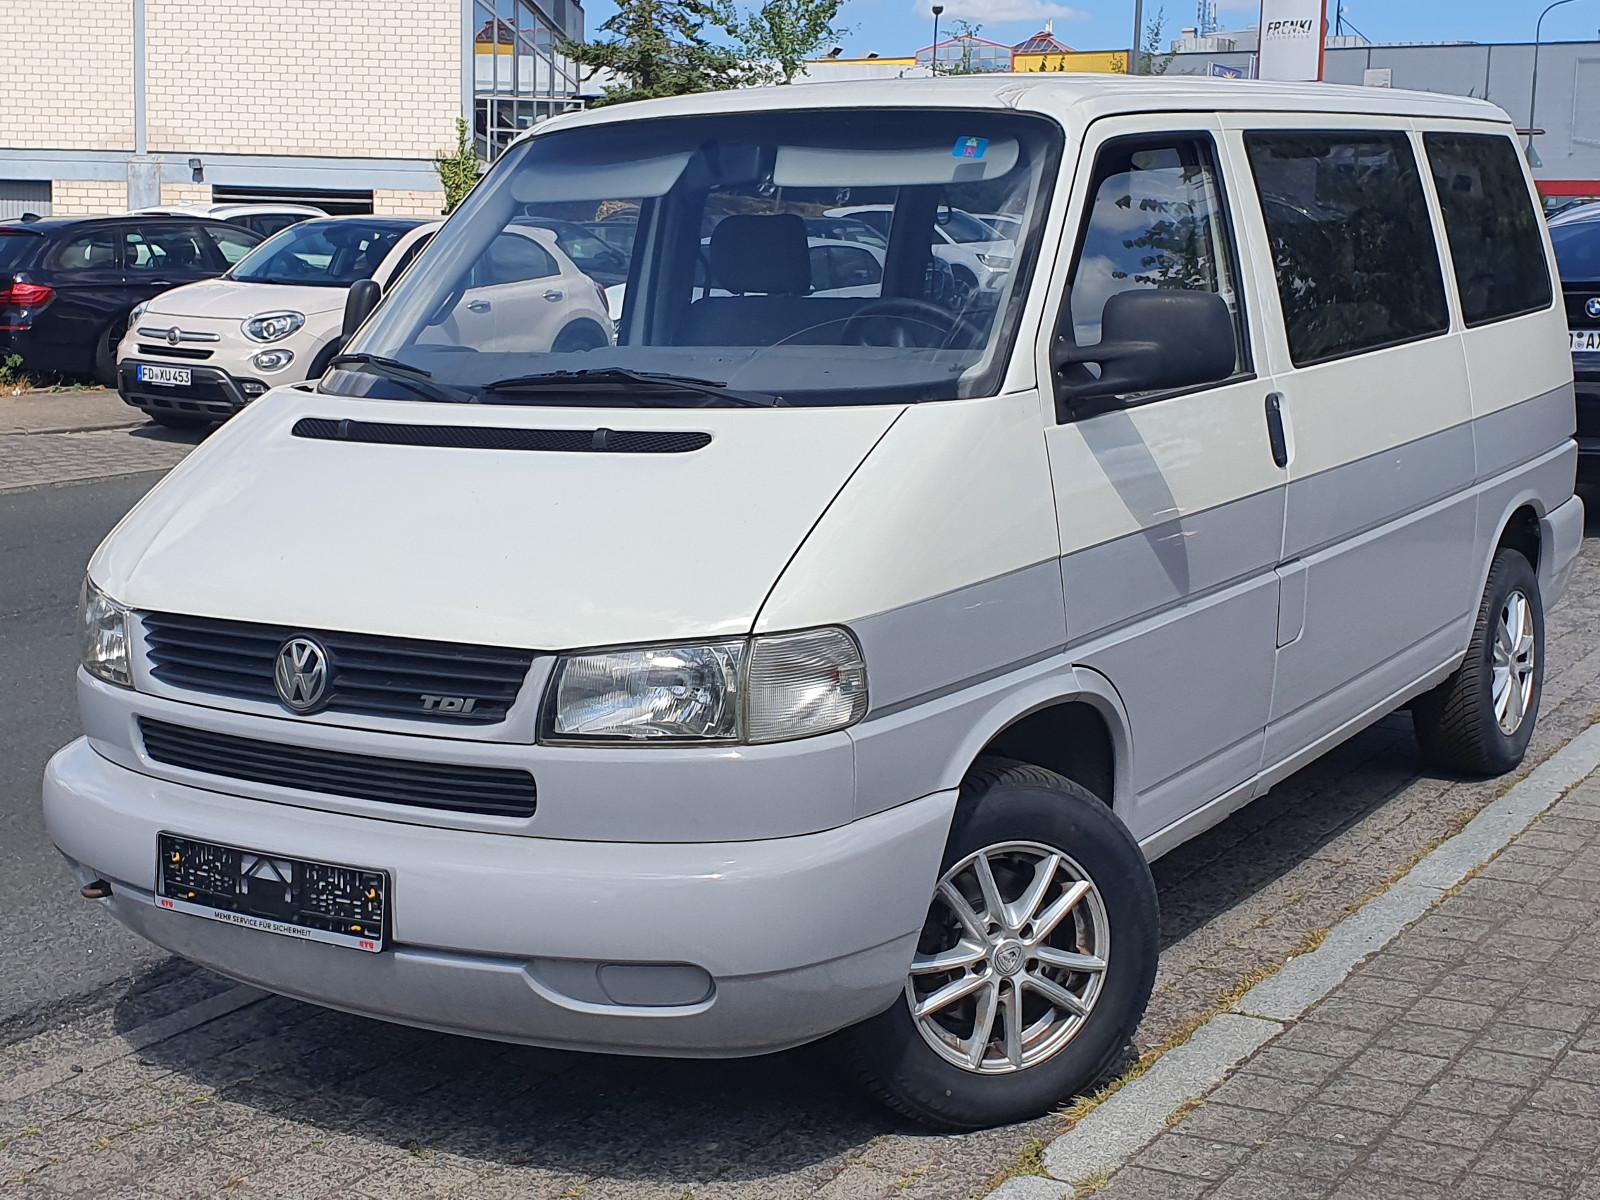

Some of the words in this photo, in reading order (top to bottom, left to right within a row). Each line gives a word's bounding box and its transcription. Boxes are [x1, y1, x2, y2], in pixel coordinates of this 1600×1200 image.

[1266, 19, 1313, 35] FRENKI
[142, 367, 154, 380] FD
[420, 694, 476, 714] TDI
[214, 911, 232, 920] MEHR
[232, 915, 257, 927] SERVICE
[258, 920, 271, 930] FÜR
[272, 924, 312, 937] SICHERHEIT
